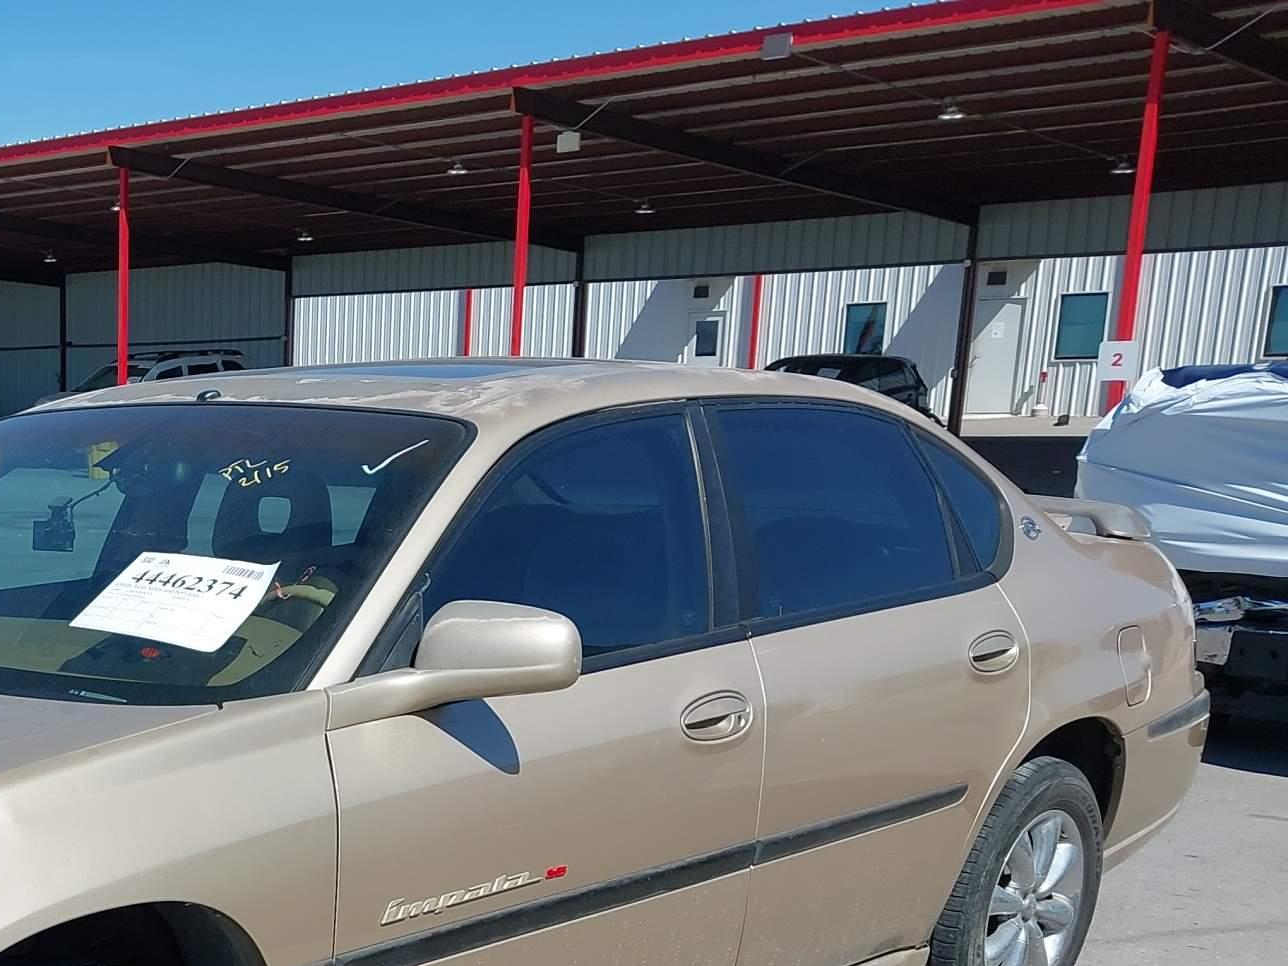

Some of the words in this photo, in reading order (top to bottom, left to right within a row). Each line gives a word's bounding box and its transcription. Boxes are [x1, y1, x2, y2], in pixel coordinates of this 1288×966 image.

[1110, 352, 1124, 367] 2
[131, 570, 248, 600] 44462374
[379, 870, 544, 928] Impala
